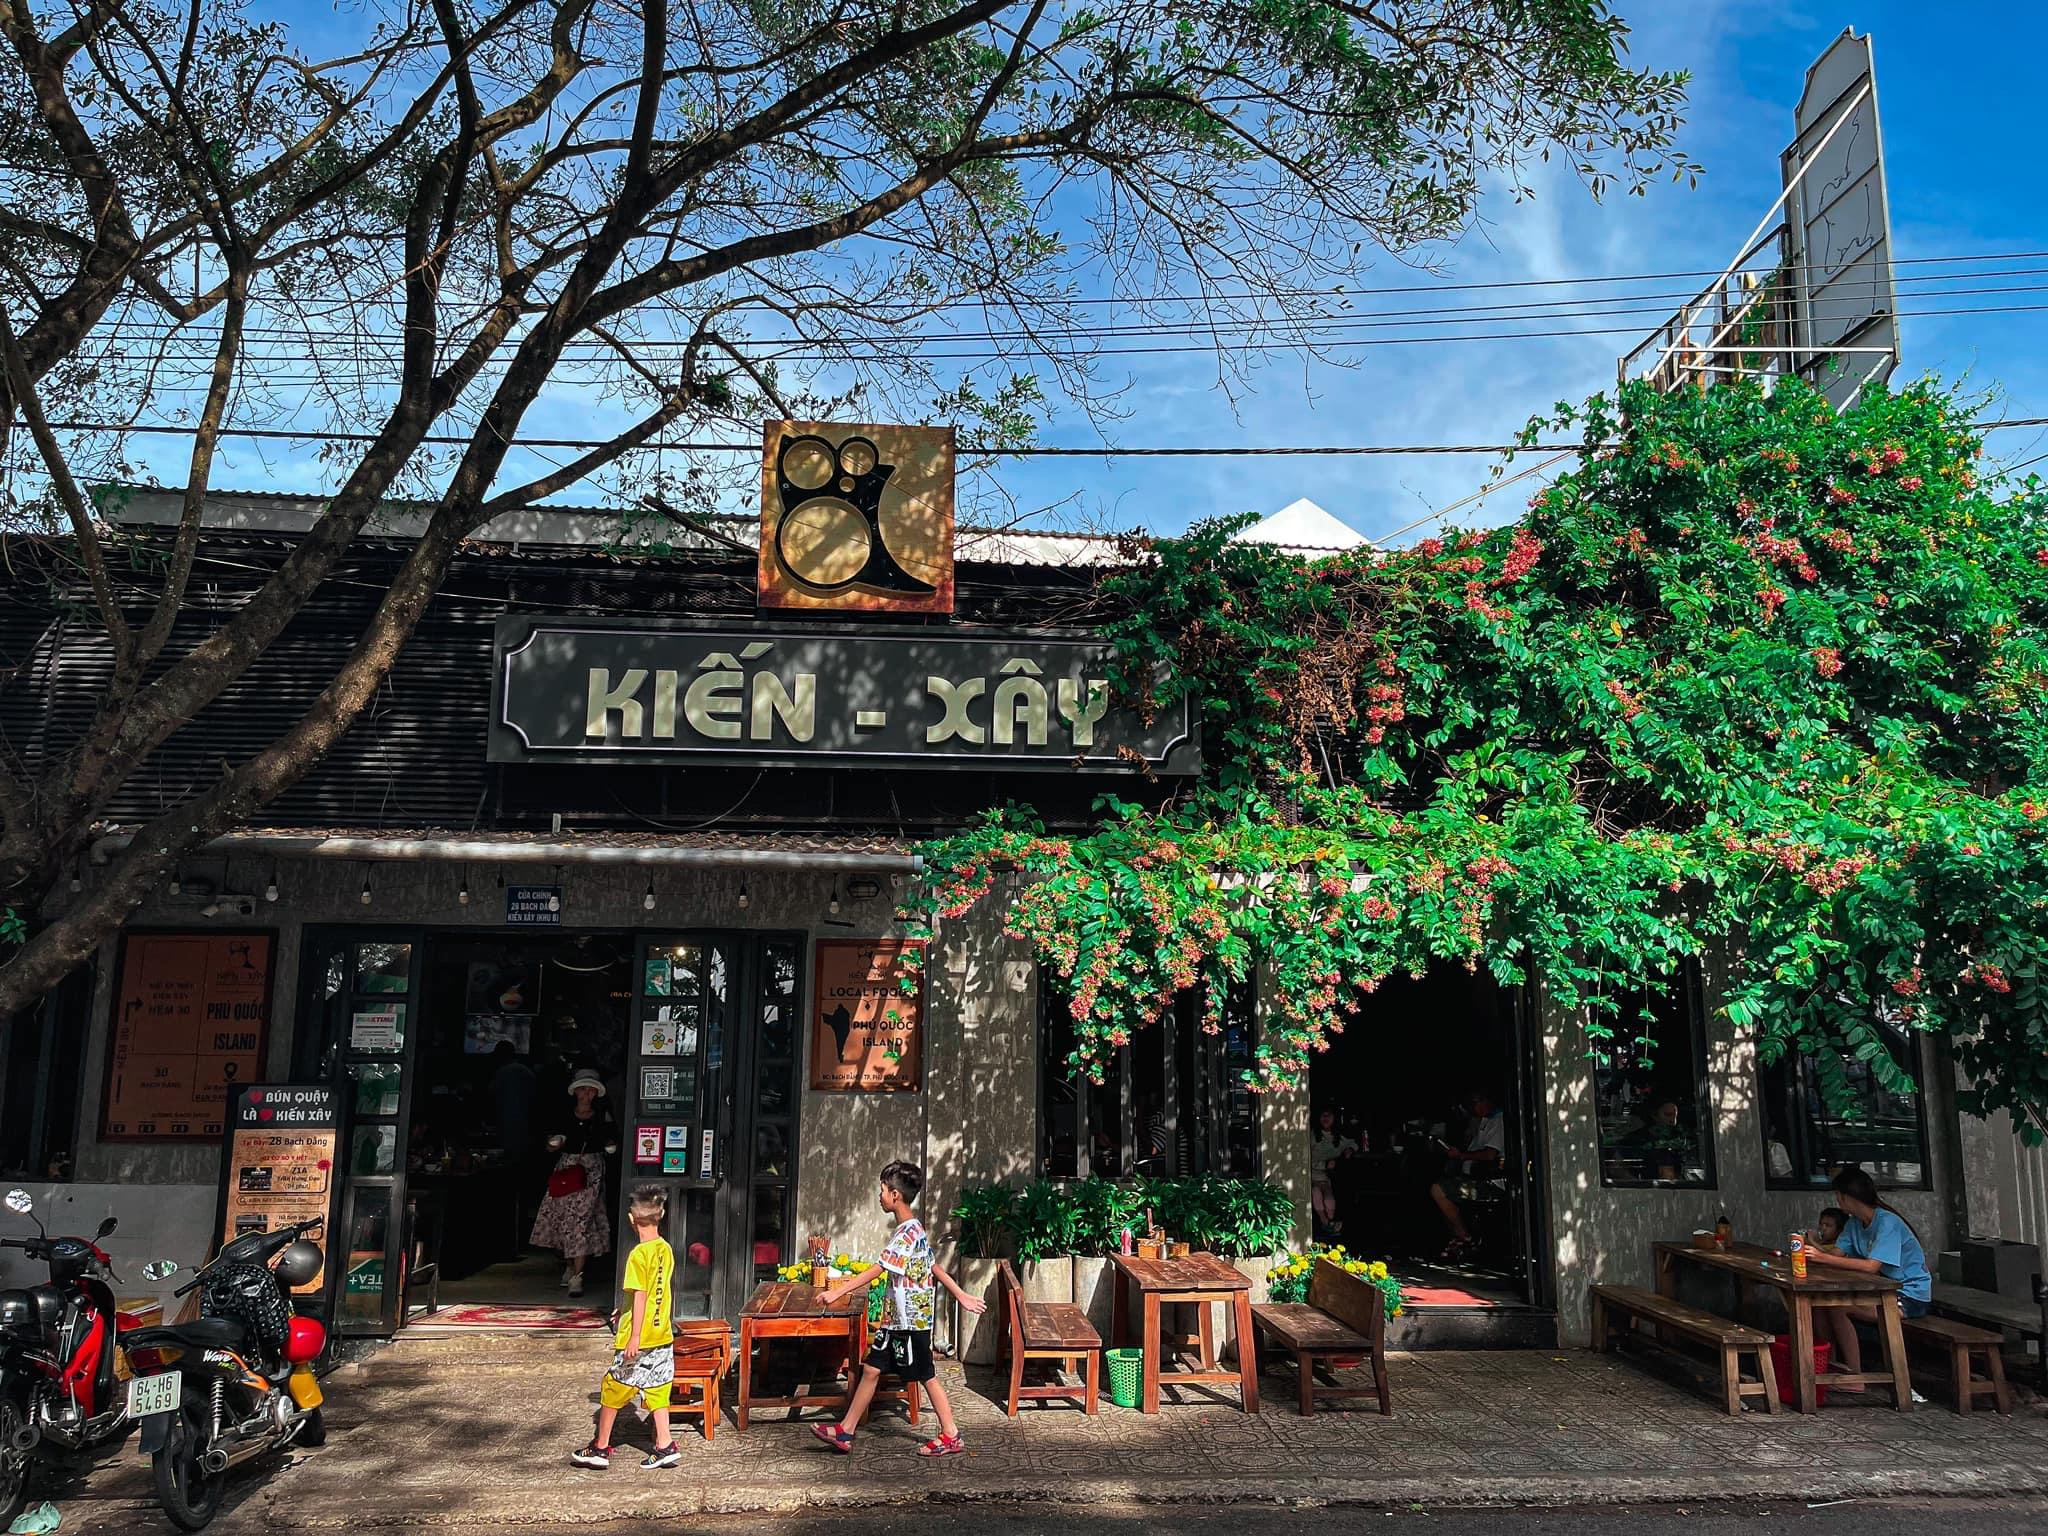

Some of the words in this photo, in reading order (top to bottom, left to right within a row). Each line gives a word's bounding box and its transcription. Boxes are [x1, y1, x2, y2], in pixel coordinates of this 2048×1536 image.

[586, 642, 817, 743] KIẾN
[926, 657, 1109, 747] XÂY
[830, 987, 868, 997] LOCAL
[214, 1033, 256, 1050] ISLAND
[863, 1038, 903, 1047] ISLAND
[265, 1089, 291, 1103] BÚN
[294, 1088, 330, 1105] QUẬY
[242, 1107, 257, 1121] LÀ
[276, 1106, 305, 1121] KIẾN
[308, 1107, 332, 1121] XÂY
[270, 1136, 282, 1145] 28
[202, 1348, 233, 1362] Wave
[136, 1375, 173, 1396] 64-H6
[135, 1392, 171, 1413] 5469
